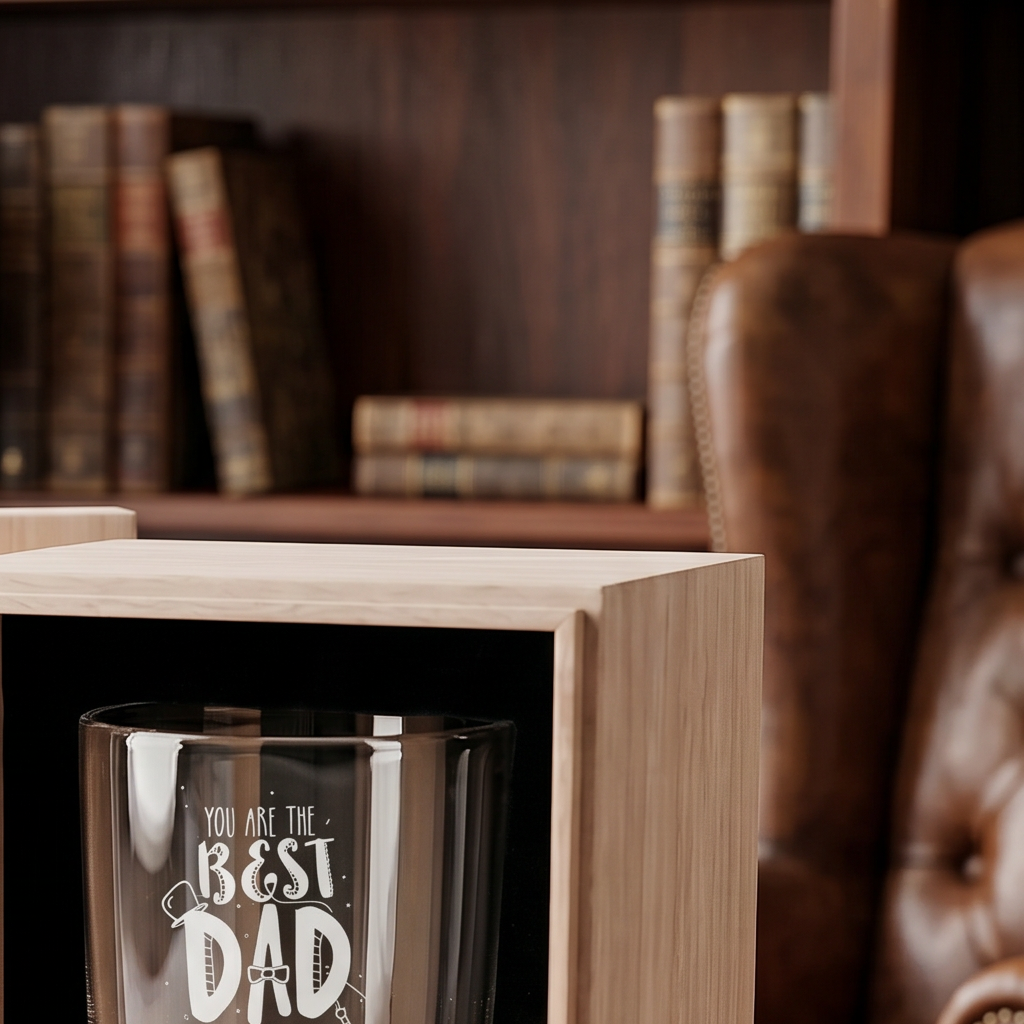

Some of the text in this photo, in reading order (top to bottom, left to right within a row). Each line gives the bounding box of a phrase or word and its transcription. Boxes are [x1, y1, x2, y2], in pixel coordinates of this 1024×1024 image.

[204, 805, 316, 838] YOU ARE THE
[198, 837, 335, 905] BEST
